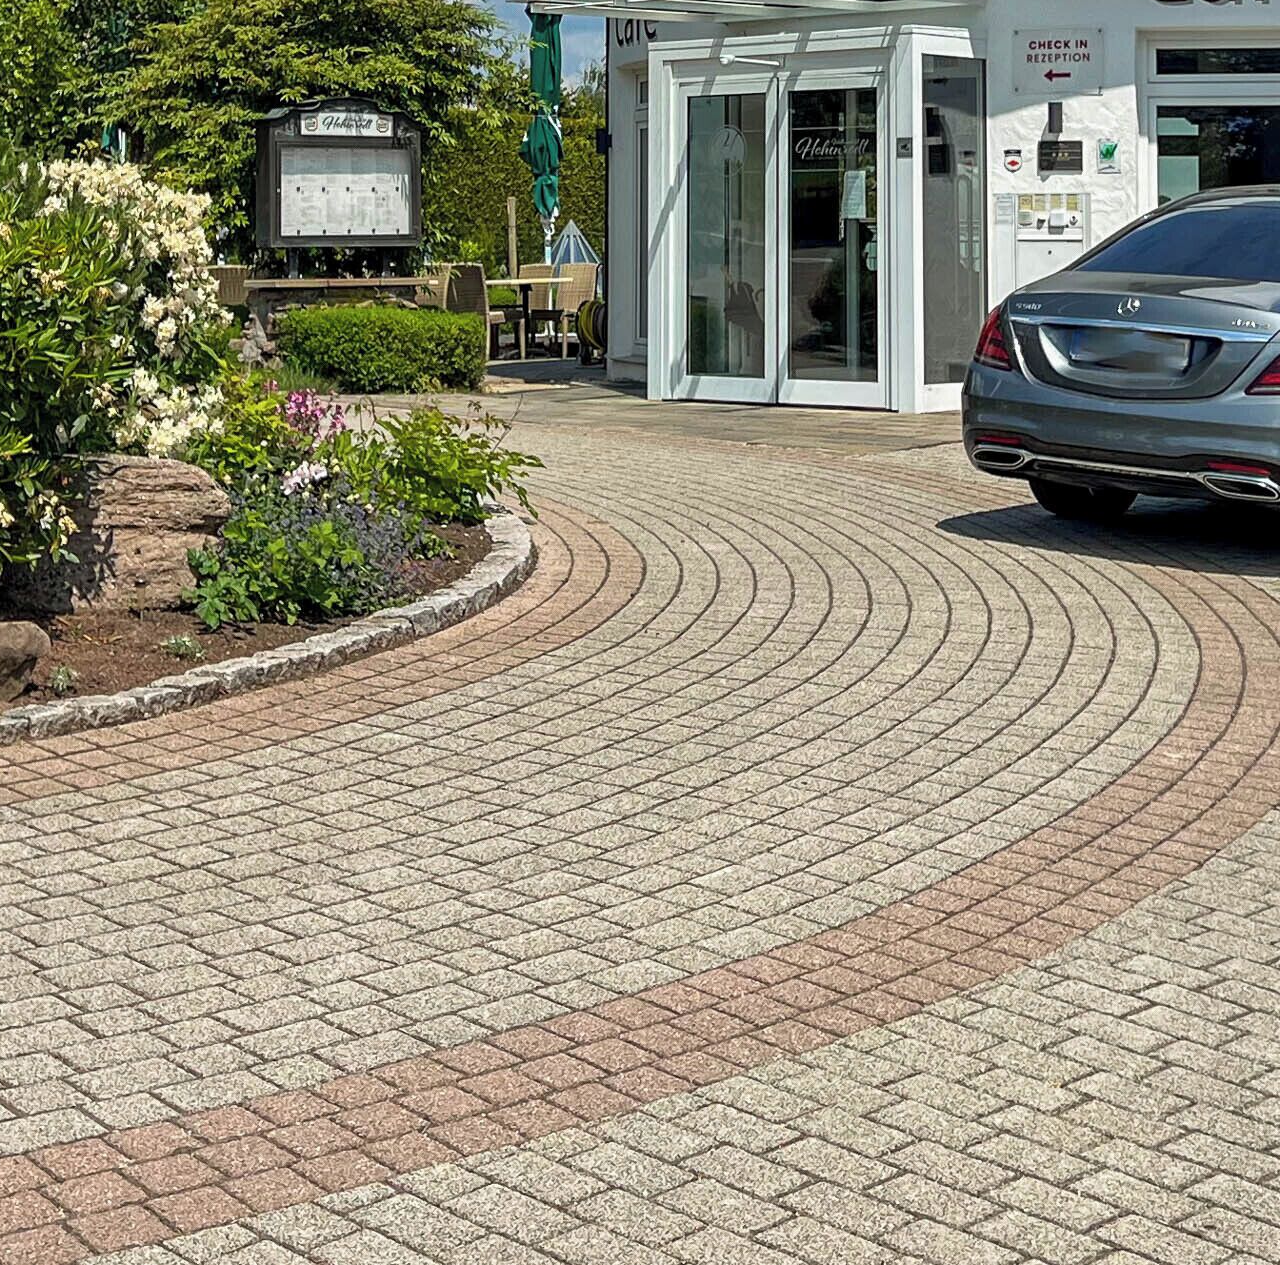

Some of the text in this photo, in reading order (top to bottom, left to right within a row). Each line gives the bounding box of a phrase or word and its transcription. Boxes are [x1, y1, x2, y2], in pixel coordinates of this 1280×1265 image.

[1028, 39, 1088, 50] CHECK IN
[1026, 52, 1091, 64] REZEPTION
